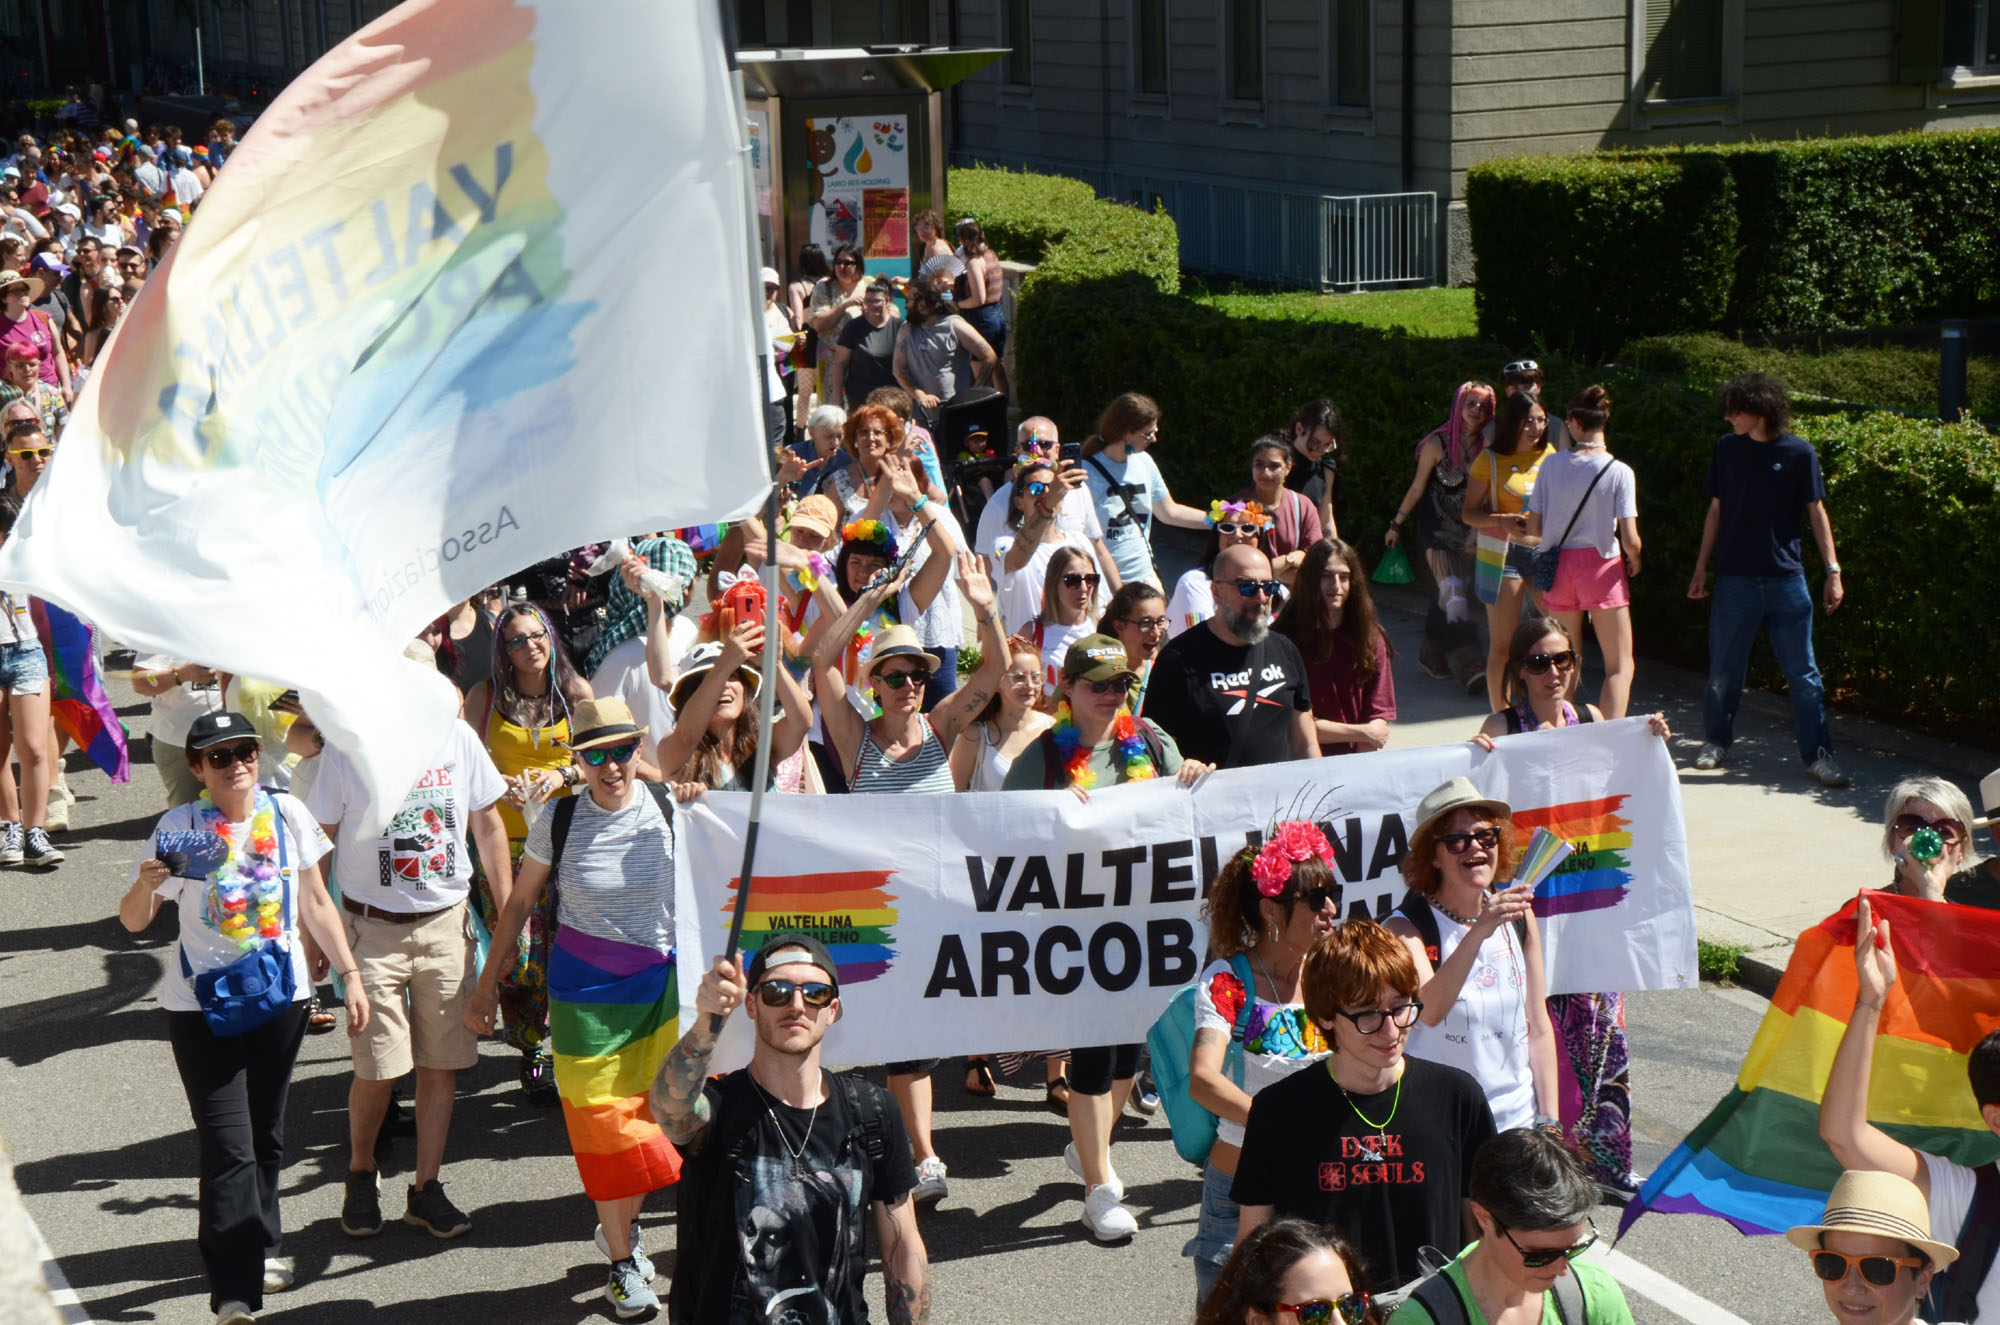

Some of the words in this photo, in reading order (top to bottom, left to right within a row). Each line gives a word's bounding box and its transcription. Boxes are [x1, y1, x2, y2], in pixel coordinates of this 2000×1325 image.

[768, 915, 853, 930] VALTELLINA
[1445, 1033, 1468, 1044] ROCK
[1351, 1161, 1426, 1185] SOULS
